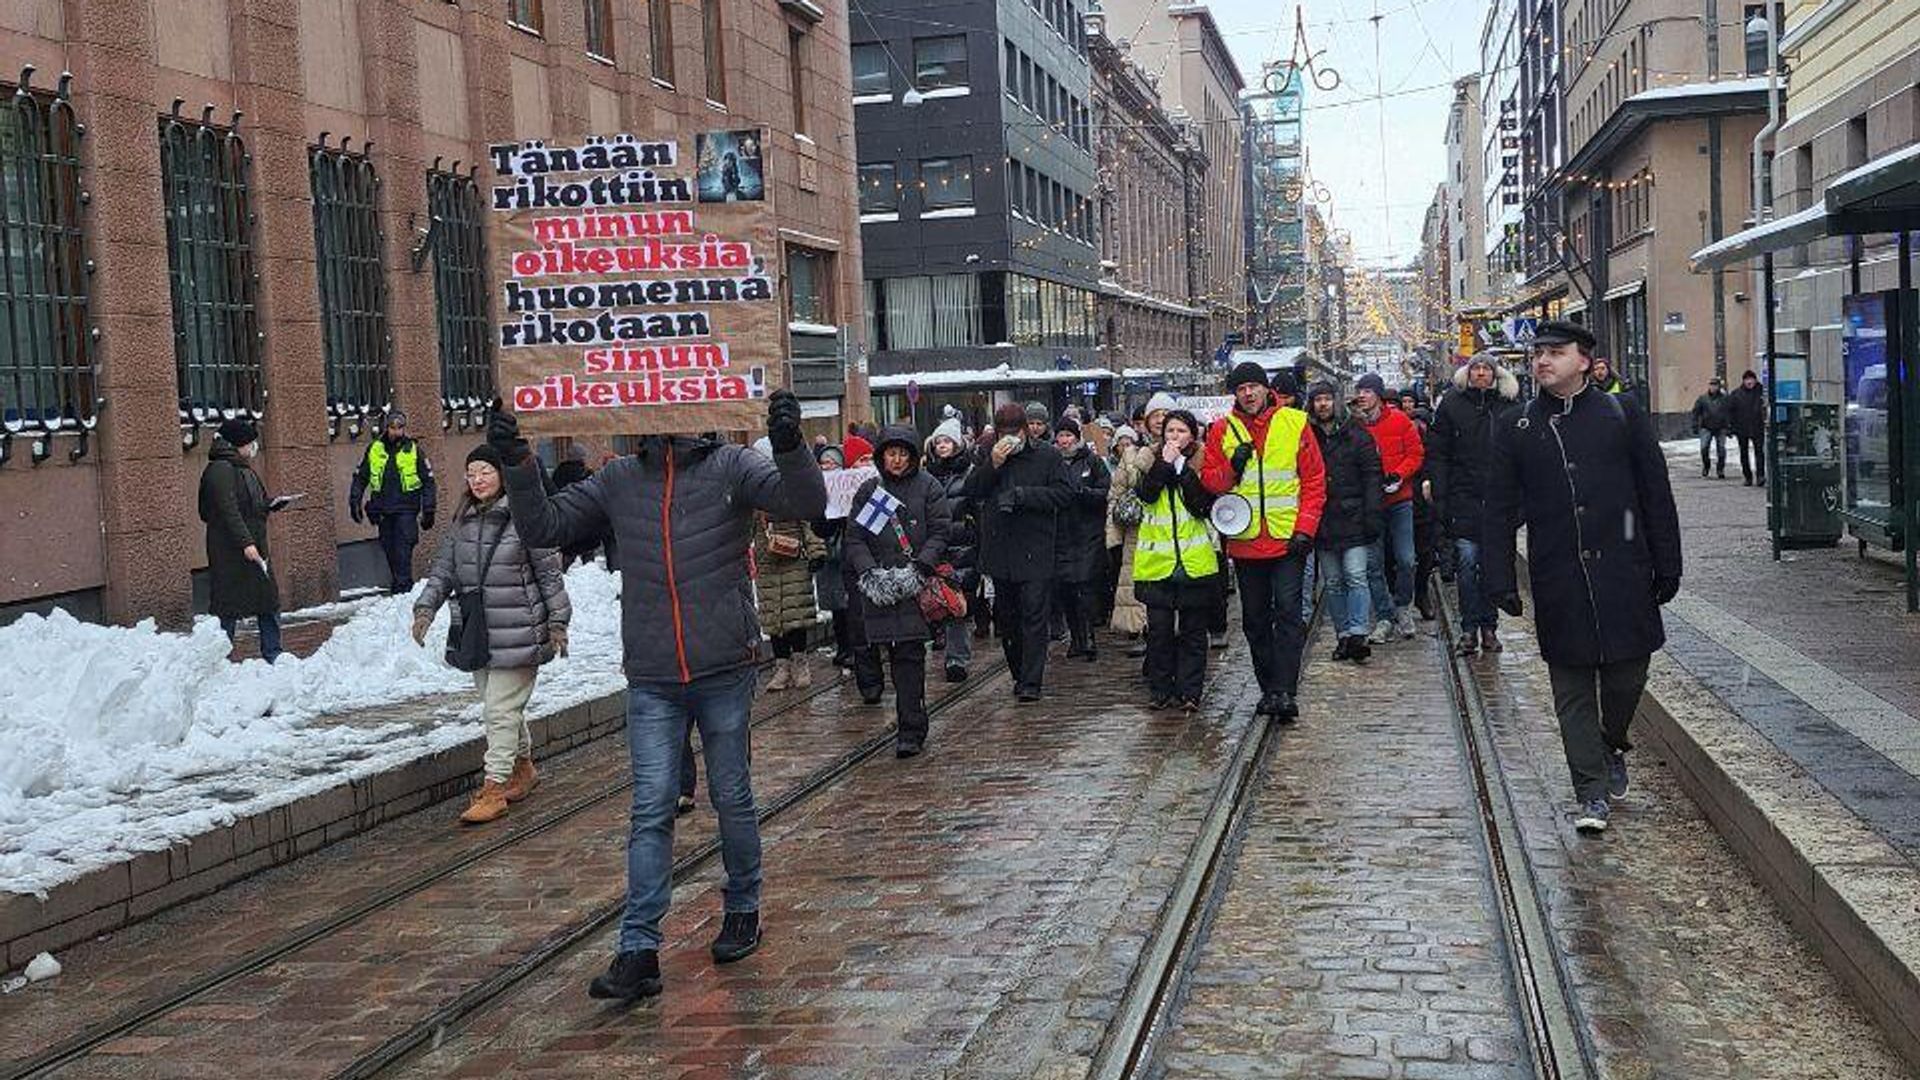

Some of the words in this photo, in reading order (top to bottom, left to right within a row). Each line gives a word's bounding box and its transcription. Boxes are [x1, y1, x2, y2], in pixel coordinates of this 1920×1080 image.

[490, 134, 672, 175] Tänään
[493, 171, 691, 208] rikottiin
[534, 208, 692, 240] minun
[514, 234, 765, 274] oikeuksia,
[506, 277, 770, 312] huomenna
[501, 312, 709, 346] rikotaan
[586, 341, 724, 372] sinun
[515, 367, 764, 409] oikeuksia!
